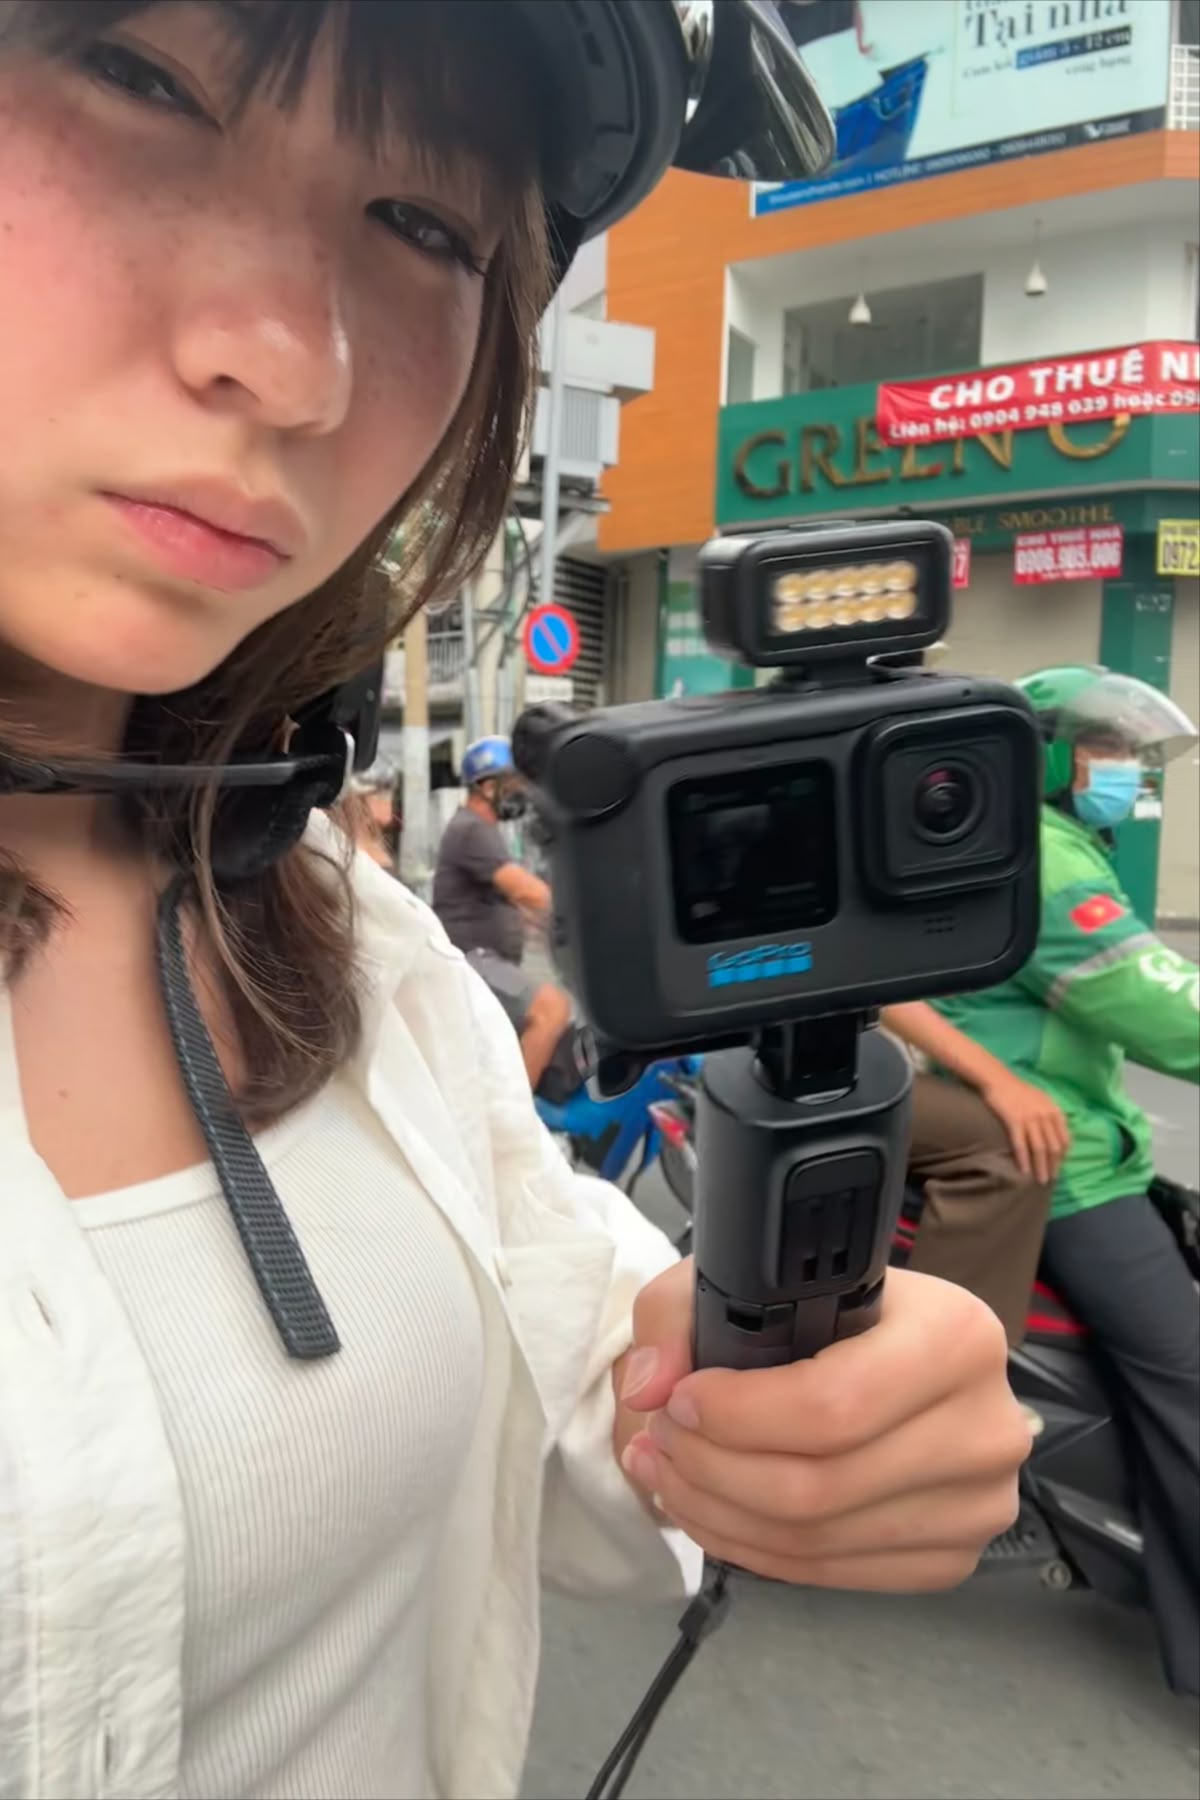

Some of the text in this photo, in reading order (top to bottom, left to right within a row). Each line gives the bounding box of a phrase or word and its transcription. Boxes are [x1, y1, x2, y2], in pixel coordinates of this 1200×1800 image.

[928, 349, 1200, 411] CHO THUÊ N
[889, 420, 931, 438] Liên
[1113, 391, 1165, 411] hoặc
